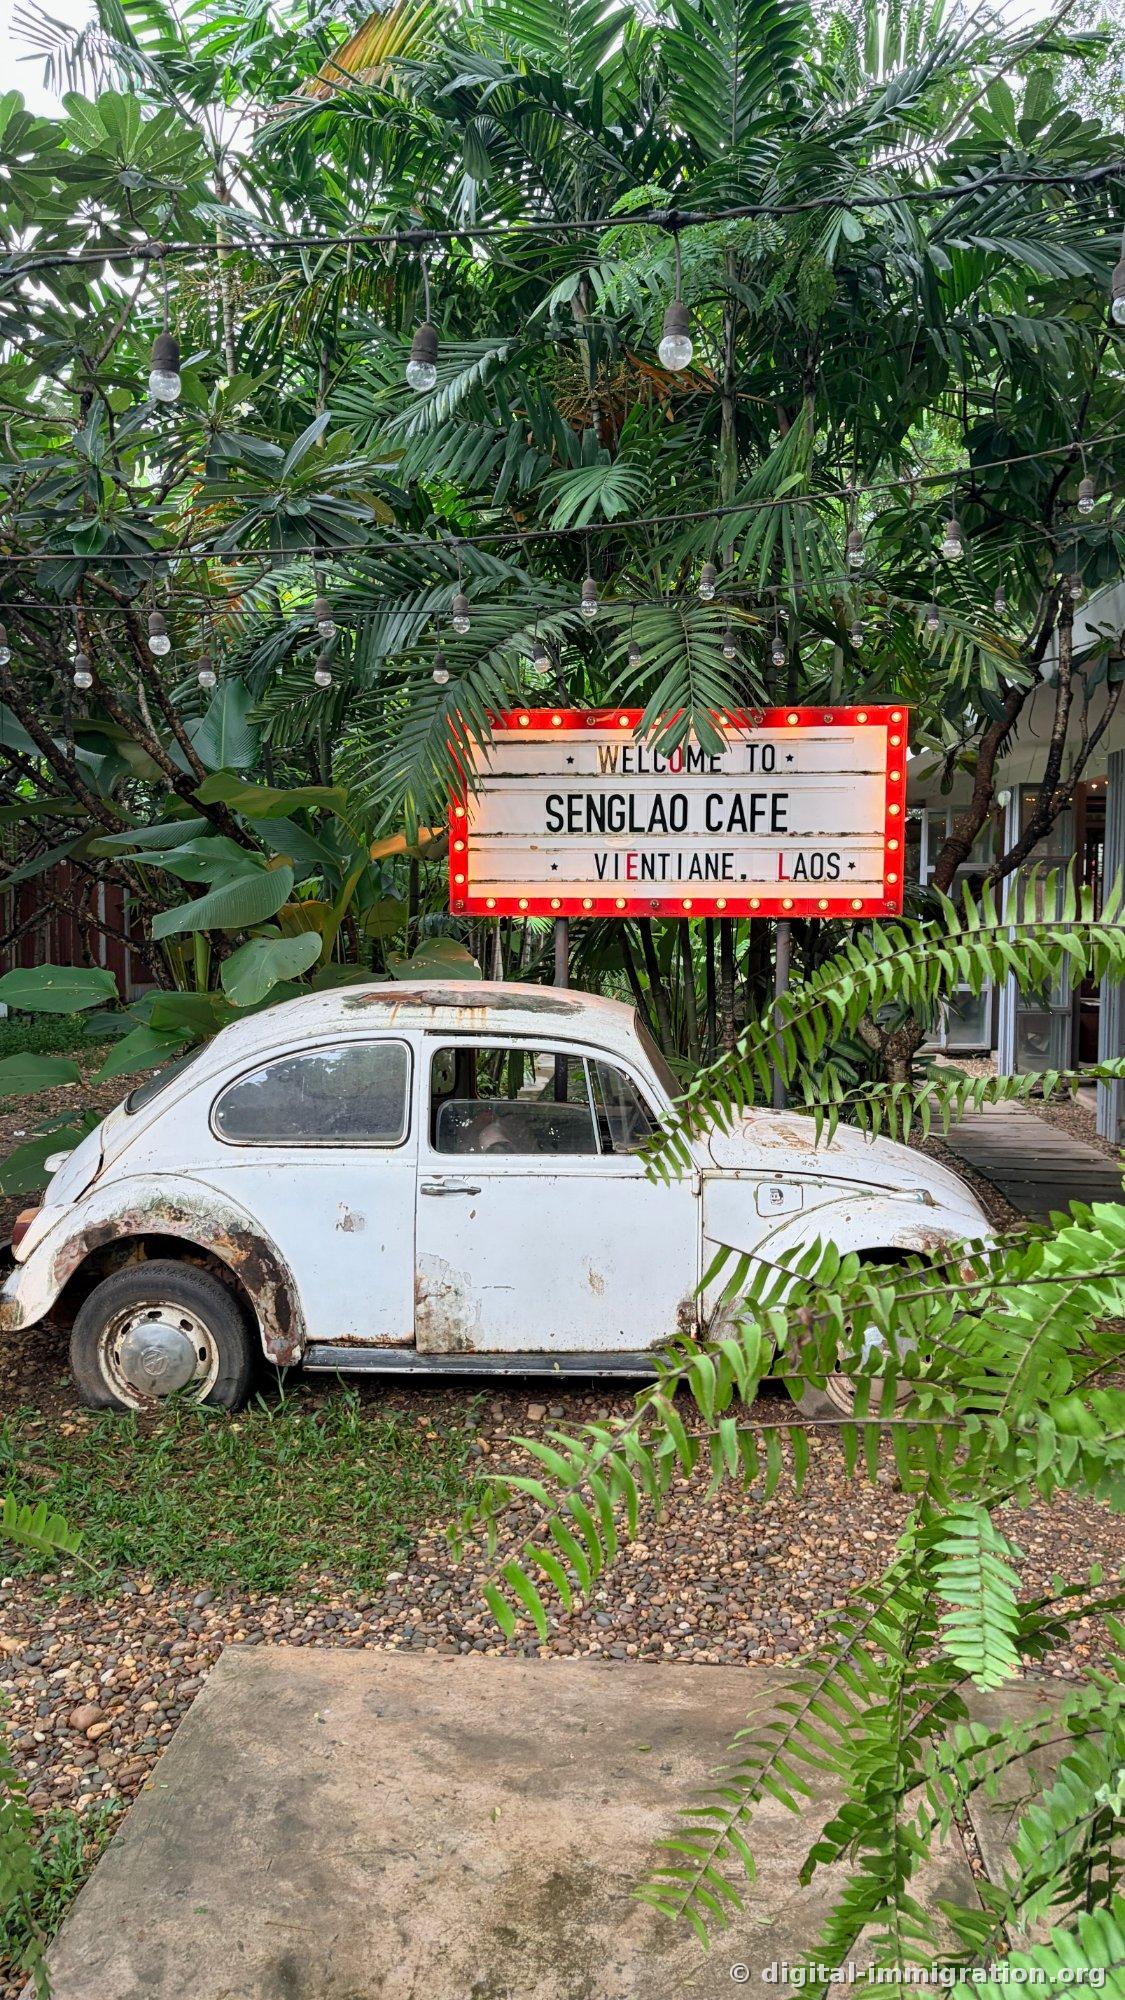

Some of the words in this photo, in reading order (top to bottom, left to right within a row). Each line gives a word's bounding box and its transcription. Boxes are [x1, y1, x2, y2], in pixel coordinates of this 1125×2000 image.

[746, 744, 776, 772] TO
[545, 793, 689, 833] SENGLAO
[705, 792, 789, 832] CAFE
[777, 852, 841, 880] LAOS
